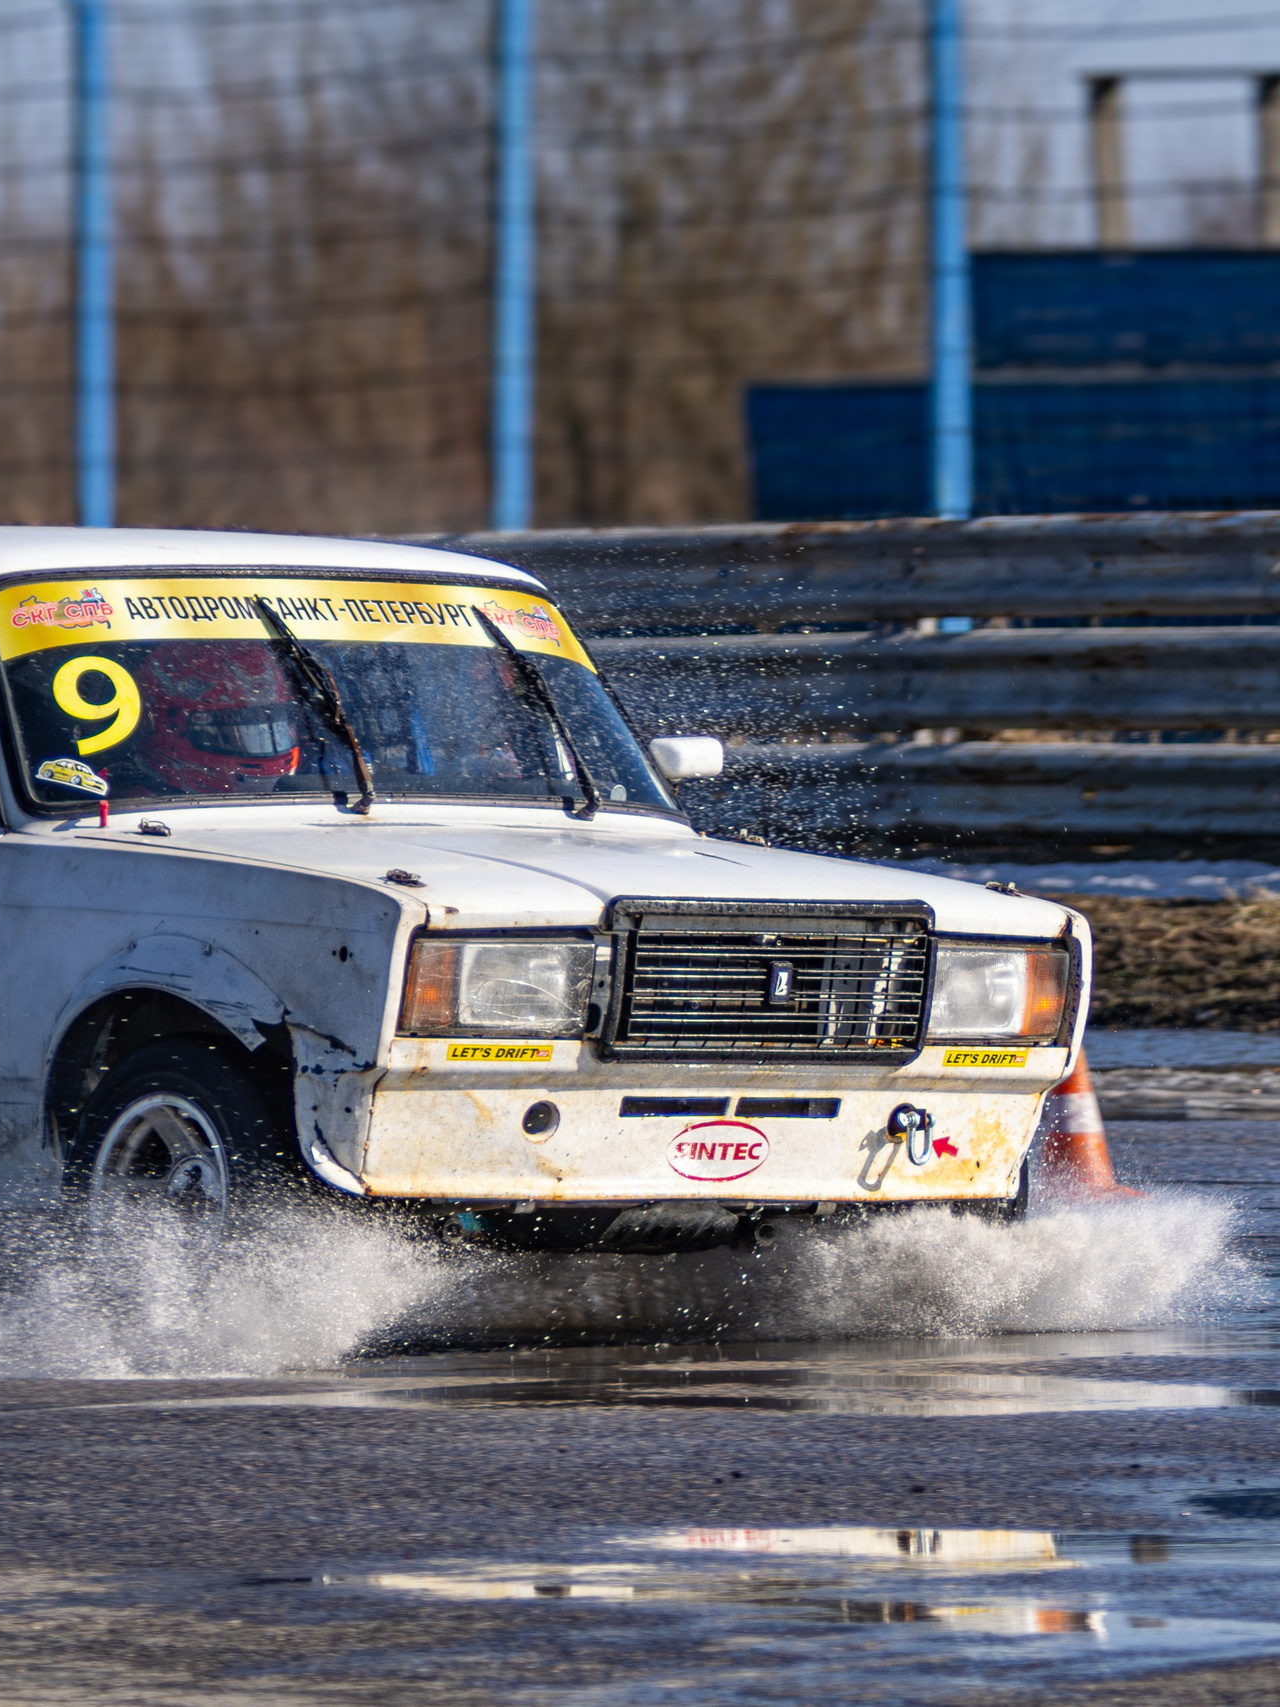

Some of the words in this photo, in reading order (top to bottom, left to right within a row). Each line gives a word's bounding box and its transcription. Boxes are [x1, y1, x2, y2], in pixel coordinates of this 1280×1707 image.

[11, 605, 58, 628] СКГ
[64, 602, 114, 619] СПБ
[123, 595, 261, 622] АВТОДРОМ
[52, 655, 141, 756] 9
[451, 1047, 492, 1058] LET'S
[946, 1053, 980, 1064] LET'S
[673, 1142, 762, 1160] SINTEC
